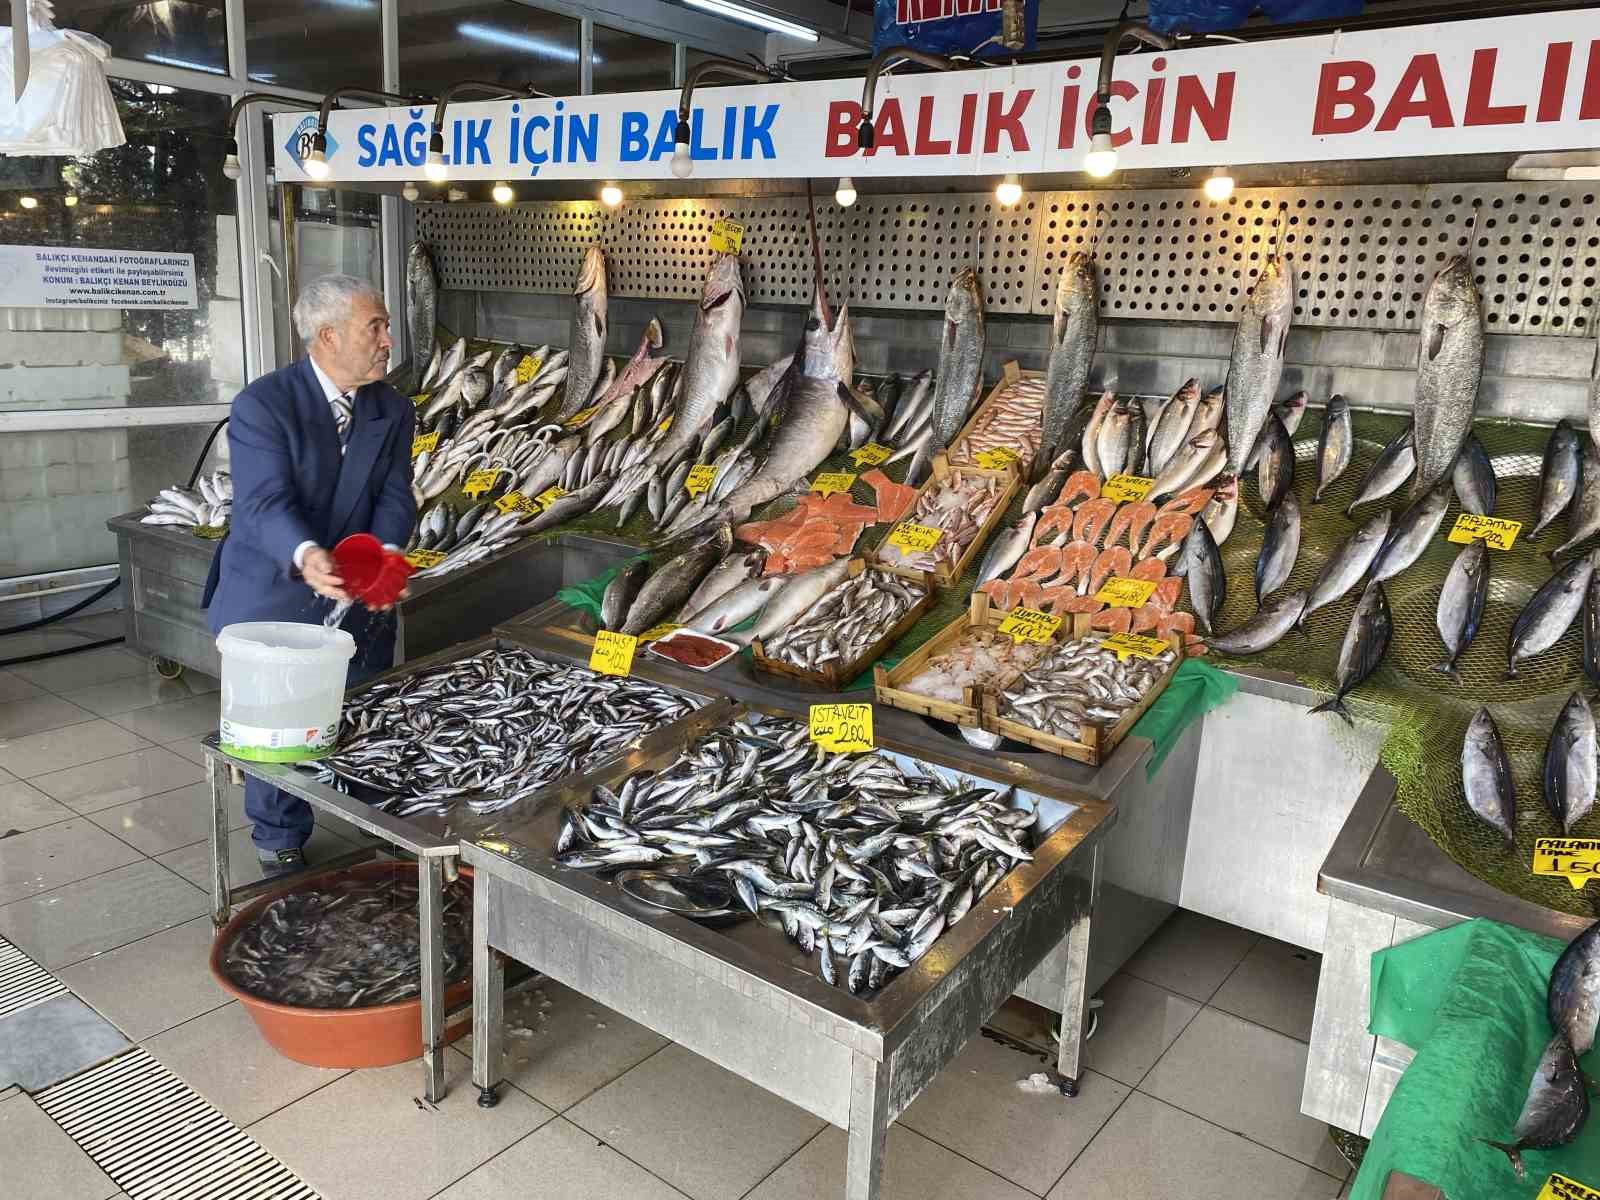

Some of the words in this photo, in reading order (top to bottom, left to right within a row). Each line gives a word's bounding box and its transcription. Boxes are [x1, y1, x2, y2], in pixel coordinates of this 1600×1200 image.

[825, 88, 1035, 158] BALIK
[509, 100, 599, 177] İÇİN
[620, 103, 780, 162] BALIK
[36, 253, 71, 262] BALIKÇI
[72, 255, 117, 263] KENANDAKİ
[119, 256, 190, 267] FOTOĞRAFLARINIZI
[90, 266, 114, 274] etiketi
[43, 276, 73, 284] KONUM
[80, 277, 111, 285] BALIKÇI
[1459, 514, 1521, 532] PALAMUT
